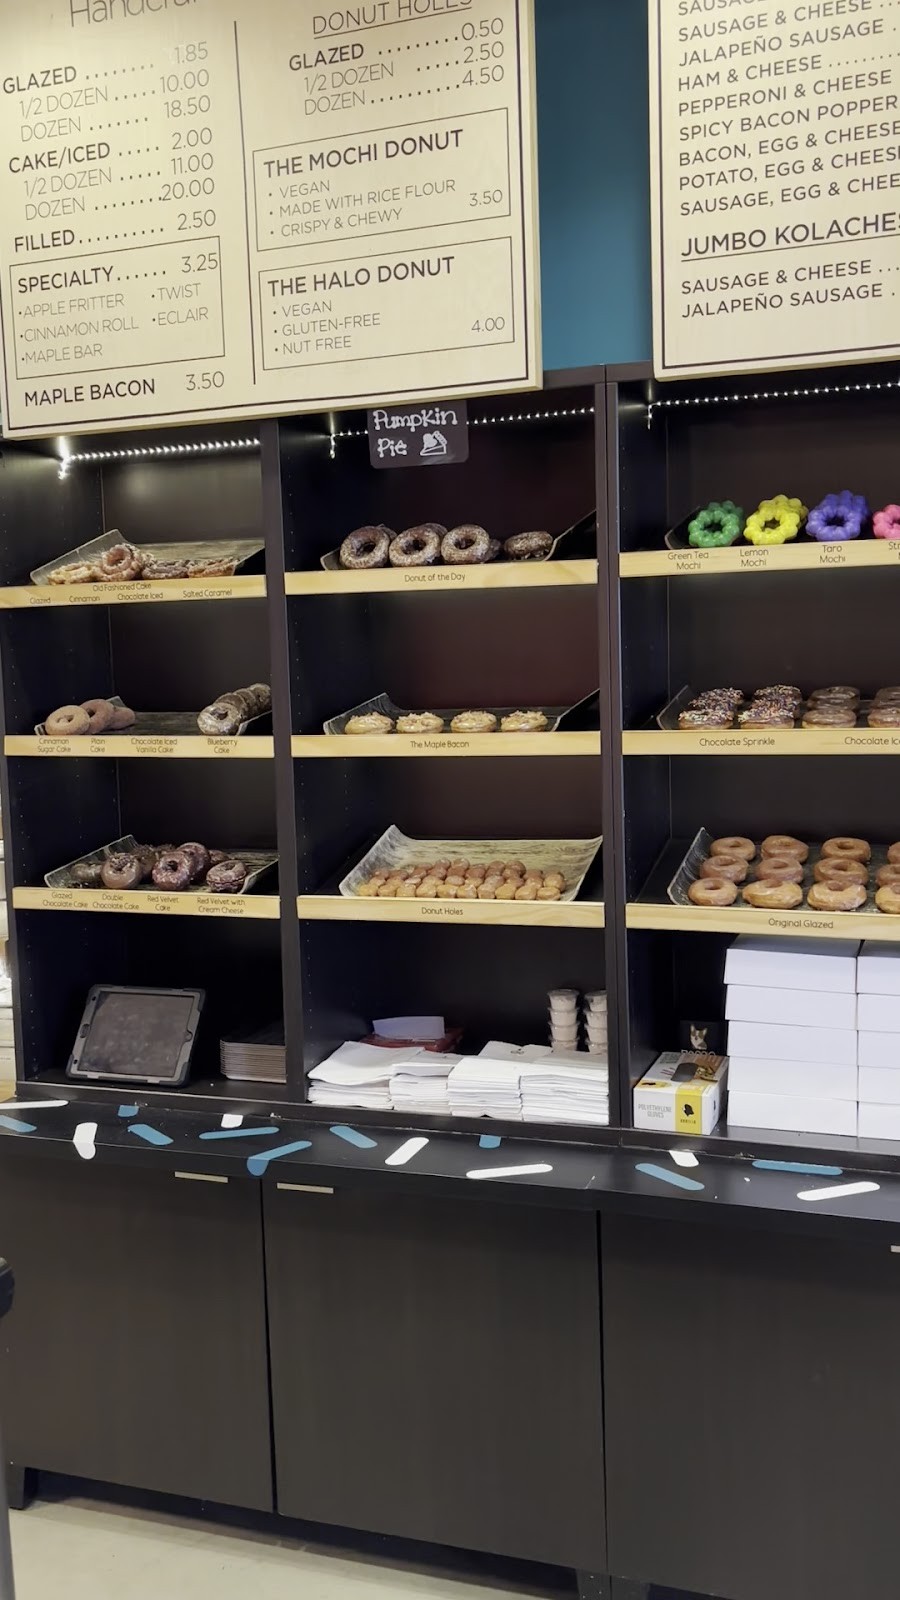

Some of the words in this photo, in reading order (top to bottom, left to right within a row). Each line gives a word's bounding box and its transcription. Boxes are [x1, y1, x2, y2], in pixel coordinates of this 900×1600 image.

[312, 2, 389, 35] DONUT
[678, 13, 768, 42] SAUSAGE
[775, 10, 787, 25] &
[794, 0, 872, 21] CHEESE
[289, 44, 364, 70] GLAZED
[462, 18, 504, 40] 0.50
[679, 35, 782, 67] JALAPEÑO
[790, 18, 884, 48] SAUSAGE
[3, 66, 77, 94] GLAZED
[174, 42, 208, 64] 1.85
[304, 73, 326, 94] 1/2
[332, 62, 394, 88] DOZEN
[464, 42, 504, 64] 2.50
[678, 72, 720, 92] HAM
[727, 69, 738, 83] &
[746, 55, 822, 80] CHEESE
[20, 98, 42, 119] 1/2
[46, 86, 108, 112] DOZEN
[160, 69, 210, 94] 10.00
[305, 90, 365, 115] DOZEN
[462, 65, 504, 86] 4.50
[679, 86, 787, 116] PEPPERONI
[794, 84, 806, 98] &
[813, 70, 892, 95] CHEESE
[21, 116, 81, 142] DOZEN
[164, 95, 210, 118] 18.50
[680, 120, 734, 142] SPICY
[740, 108, 810, 132] BACON
[818, 95, 898, 120] POPPER
[9, 142, 110, 173] CAKE/ICED
[172, 127, 212, 150] 2.00
[264, 156, 303, 178] THE
[310, 144, 376, 172] MOCHI
[386, 129, 463, 158] DONUT
[680, 143, 751, 166] BACON,
[759, 136, 798, 154] EGG
[806, 133, 818, 148] &
[24, 178, 46, 199] 1/2
[50, 166, 112, 192] DOZEN
[171, 152, 214, 175] 11.00
[680, 168, 758, 190] POTATO,
[765, 160, 804, 178] EGG
[812, 158, 824, 172] &
[832, 146, 900, 169] CHEES
[25, 196, 85, 220] DOZEN
[162, 178, 214, 201] 20.00
[280, 180, 330, 198] VEGAN
[280, 200, 321, 218] MADE
[325, 194, 363, 210] WITH
[368, 188, 400, 202] RICE
[406, 180, 455, 198] FLOUR
[470, 190, 502, 206] 3.50
[680, 190, 774, 216] SAUSAGE,
[782, 184, 821, 202] EGG
[828, 182, 840, 196] &
[14, 230, 75, 252] FILLED
[178, 210, 216, 230] 2.50
[281, 218, 330, 236] CRISPY
[334, 216, 343, 228] &
[348, 208, 402, 226] CHEWY
[682, 229, 766, 256] JUMBO
[18, 266, 114, 294] SPECIALTY
[181, 253, 218, 274] 3.25
[268, 276, 306, 296] THE
[314, 268, 370, 291] HALO
[378, 256, 454, 282] DONUT
[682, 272, 769, 294] SAUSAGE
[776, 270, 788, 284] &
[794, 260, 871, 282] CHEESE
[158, 283, 200, 301] TWIST
[682, 292, 782, 318] JALAPEÑO
[790, 283, 882, 306] SAUSAGE
[24, 300, 66, 318] APPLE
[70, 294, 124, 312] FRITTER
[158, 306, 208, 326] ECLAIR
[282, 300, 332, 318] VEGAN
[24, 321, 99, 342] CINNAMON
[102, 317, 139, 332] ROLL
[282, 313, 380, 336] GLUTEN-FREE
[472, 316, 505, 334] 4.00
[26, 346, 70, 364] MAPLE
[74, 343, 102, 359] BAR
[284, 340, 311, 354] NUT
[316, 336, 351, 350] FREE
[25, 385, 84, 407] MAPLE
[90, 378, 155, 400] BACON
[186, 370, 224, 391] 3.50
[373, 408, 458, 432] Pumpkin
[378, 438, 407, 458] Pie
[668, 552, 692, 560] Green
[740, 548, 768, 557] Lemon
[820, 554, 846, 564] Mochi
[822, 544, 842, 553] Taro
[676, 562, 701, 570] Mochi
[741, 559, 766, 567] Mochi
[104, 584, 135, 592] Fashioned
[404, 574, 426, 582] Donut
[451, 573, 466, 582] Day
[118, 592, 148, 600] Chocolate
[183, 590, 203, 598] Salted
[204, 588, 232, 597] Caramel
[38, 746, 54, 754] Sugar
[208, 738, 238, 746] Blueberry
[214, 746, 230, 754] Cake
[410, 740, 422, 748] The
[424, 740, 446, 750] Maple
[448, 740, 469, 748] Bacon
[700, 738, 740, 746] Chocolate
[743, 737, 775, 746] Sprinkle
[844, 736, 890, 744] Chocolate
[42, 900, 72, 908] Chocolate
[74, 900, 88, 908] Cake
[124, 902, 140, 910] Cake
[221, 906, 244, 914] Cheese
[444, 908, 463, 916] Holes
[768, 918, 802, 928] Original
[804, 920, 834, 928] Glazed
